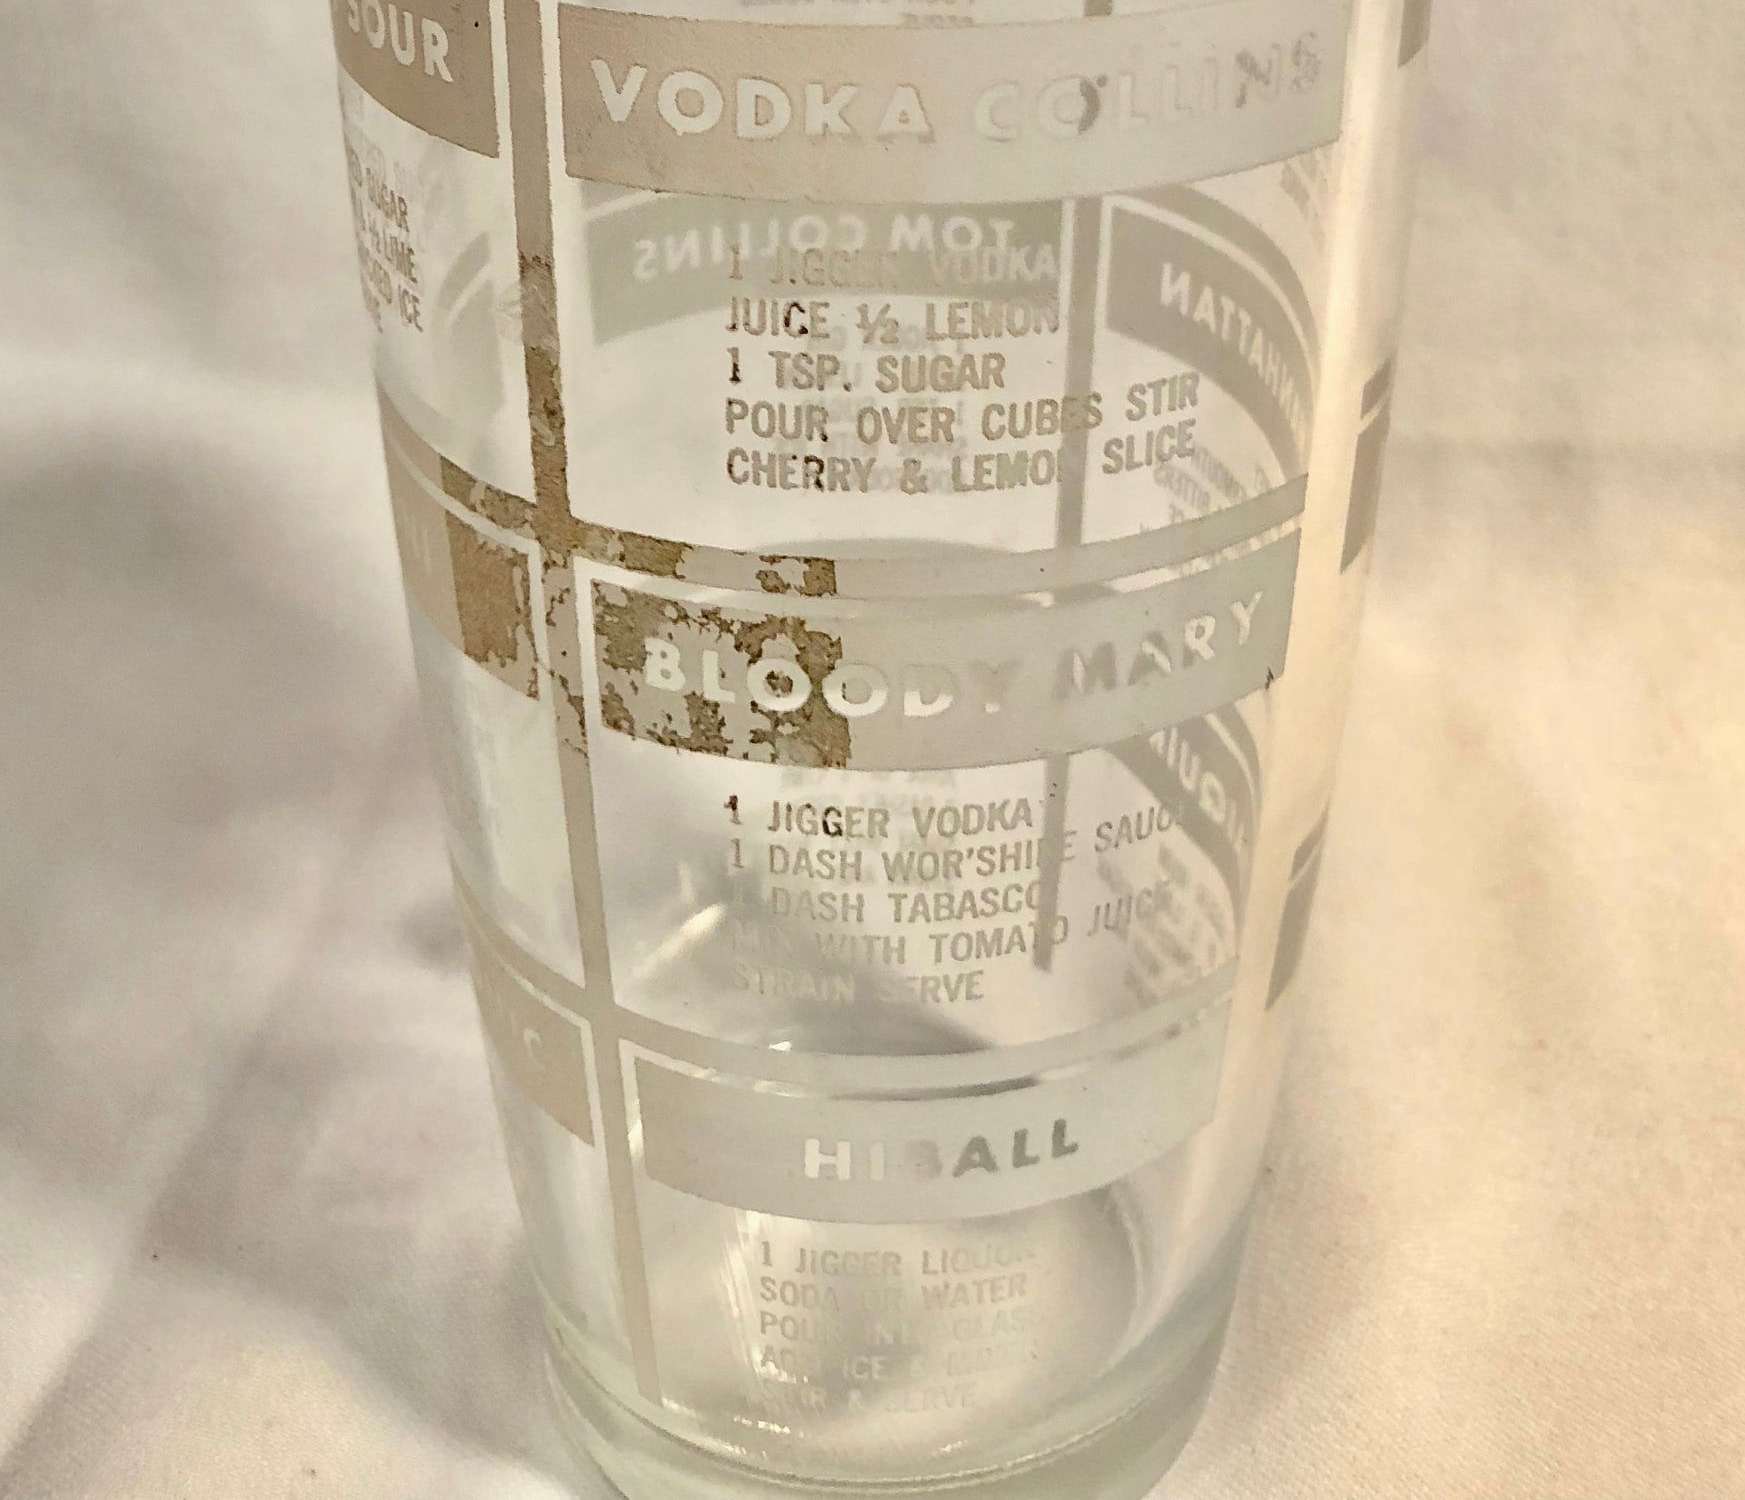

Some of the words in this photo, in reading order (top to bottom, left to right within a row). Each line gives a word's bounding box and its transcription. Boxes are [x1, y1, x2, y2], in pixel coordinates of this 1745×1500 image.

[590, 57, 938, 143] VODKA
[973, 30, 1324, 144] COLLINS
[728, 243, 744, 281] 1
[928, 242, 1058, 286] VODKA
[726, 297, 830, 340] JUICE
[925, 295, 1058, 342] LEMON
[726, 346, 741, 384] 1
[768, 349, 852, 393] TSP.
[875, 352, 1007, 394] SUGAR
[726, 396, 830, 443] POUR
[857, 403, 956, 445] OVER
[981, 392, 1102, 440] CUBES
[1125, 372, 1200, 423] STIR
[727, 447, 876, 494] CHERRY
[900, 457, 929, 496] &
[951, 448, 1072, 493] LEMO
[1102, 419, 1196, 476] SLICE
[645, 635, 1023, 718] BLOODY
[1055, 592, 1266, 702] MARY
[723, 794, 743, 825] 1
[768, 800, 891, 840] JIGGER
[912, 796, 1033, 839] VODKA
[731, 837, 745, 870] 1
[769, 843, 863, 882] DASH
[1095, 802, 1178, 852] SAUC
[771, 886, 865, 923] DASH
[887, 879, 1042, 924] TABASCO
[814, 931, 906, 965] WITH
[804, 1118, 1079, 1182] HIBALL
[760, 1239, 774, 1267] 1
[795, 1246, 902, 1277] JIGGER
[760, 1276, 841, 1312] SODA
[920, 1271, 1028, 1311] WATER
